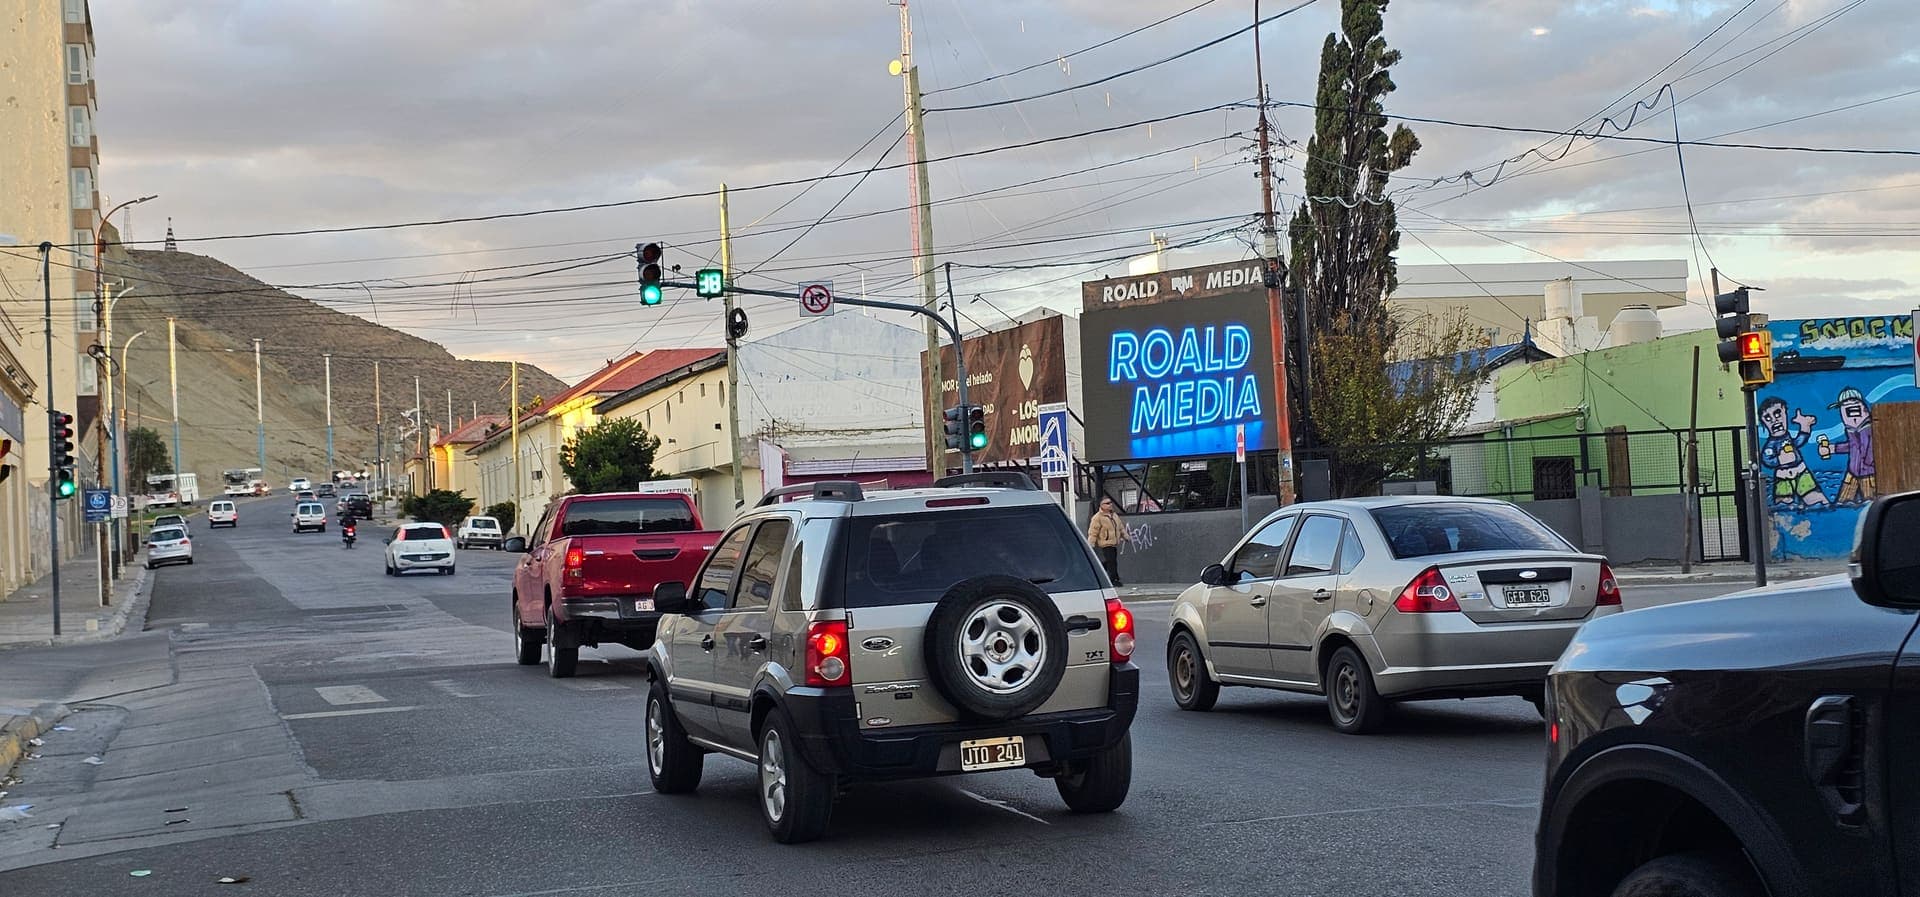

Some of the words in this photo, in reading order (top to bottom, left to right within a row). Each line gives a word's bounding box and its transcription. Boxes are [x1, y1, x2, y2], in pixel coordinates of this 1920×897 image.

[1103, 280, 1159, 303] ROALD
[1206, 266, 1263, 290] MEDIA
[1110, 325, 1251, 381] ROALD
[965, 374, 972, 387] el
[972, 371, 993, 385] helado
[1019, 399, 1038, 421] LOS
[1131, 374, 1261, 434] MEDIA
[1009, 425, 1040, 446] AMOR
[1530, 589, 1549, 603] 626
[1085, 650, 1105, 659] TXT
[964, 746, 989, 765] JTO
[996, 743, 1022, 761] 241
